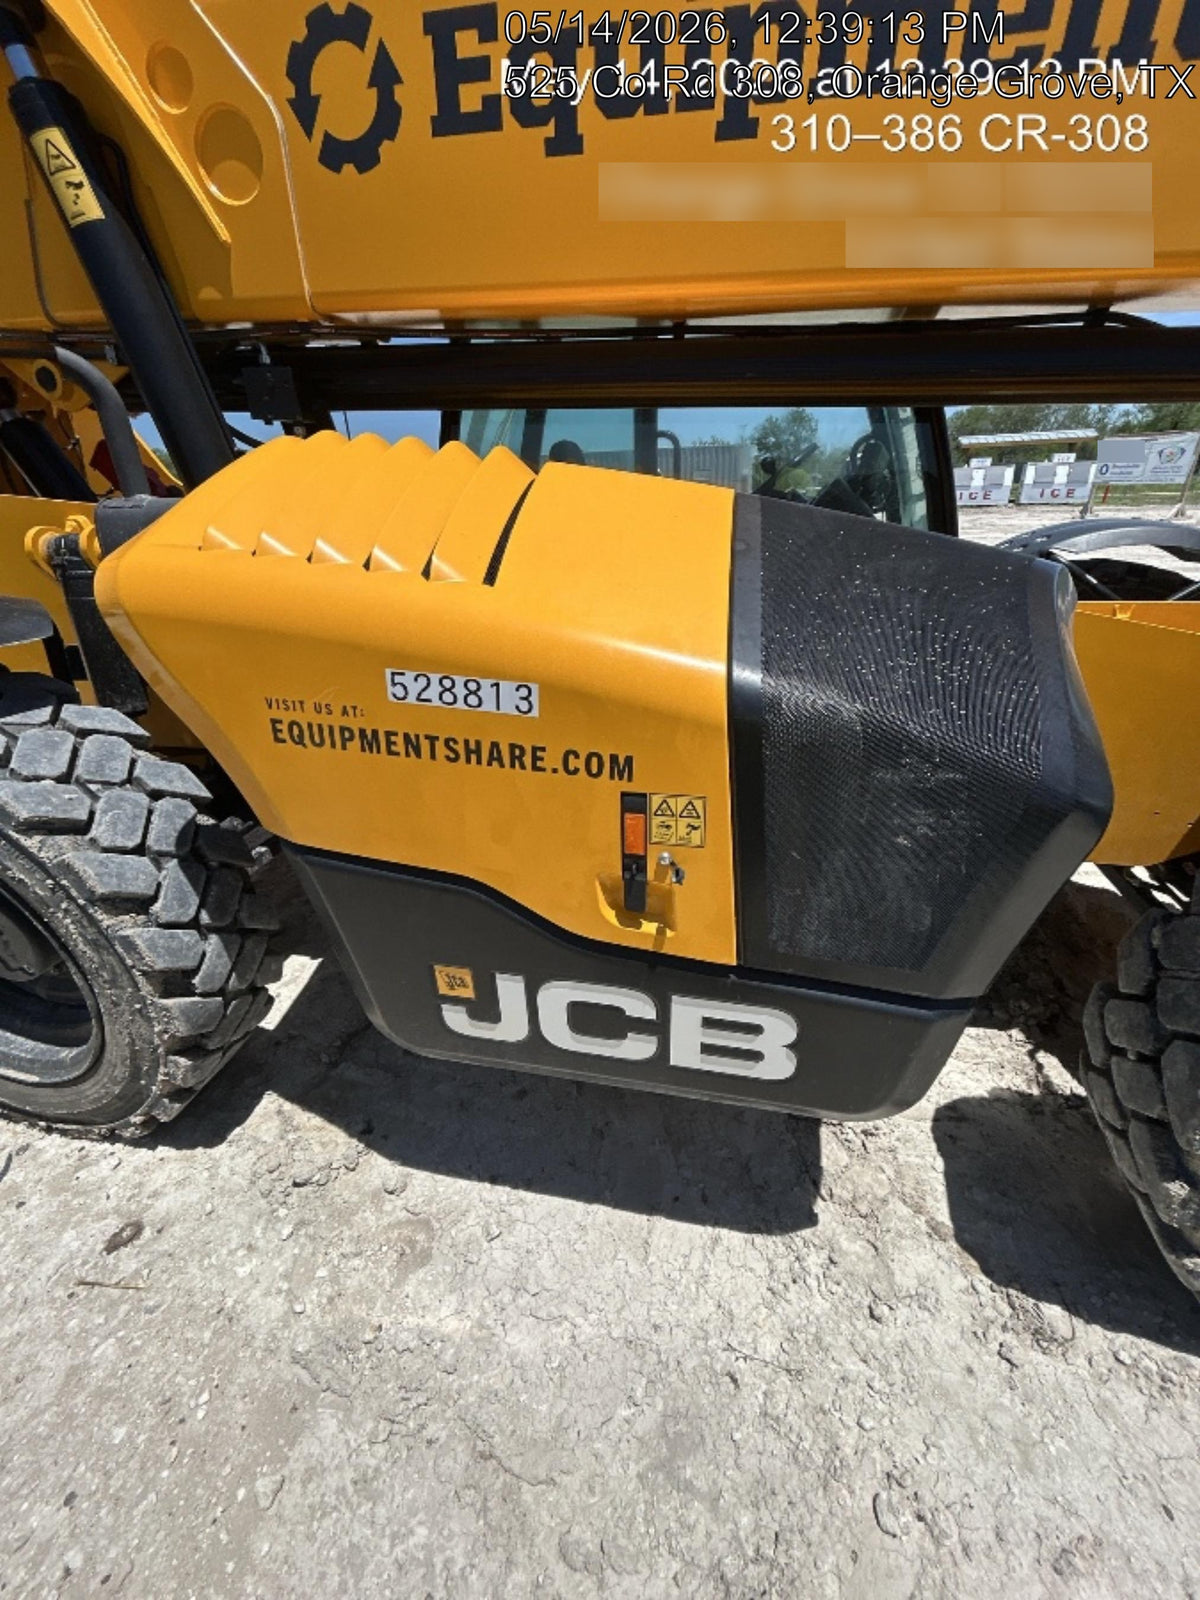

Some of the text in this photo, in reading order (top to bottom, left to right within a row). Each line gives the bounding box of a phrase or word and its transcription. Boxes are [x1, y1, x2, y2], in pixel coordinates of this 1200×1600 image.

[265, 697, 364, 718] VISIT US AT:
[389, 671, 534, 715] 528813
[269, 717, 635, 783] EQUIPMENTSHARE.COM
[441, 973, 798, 1081] JCB
